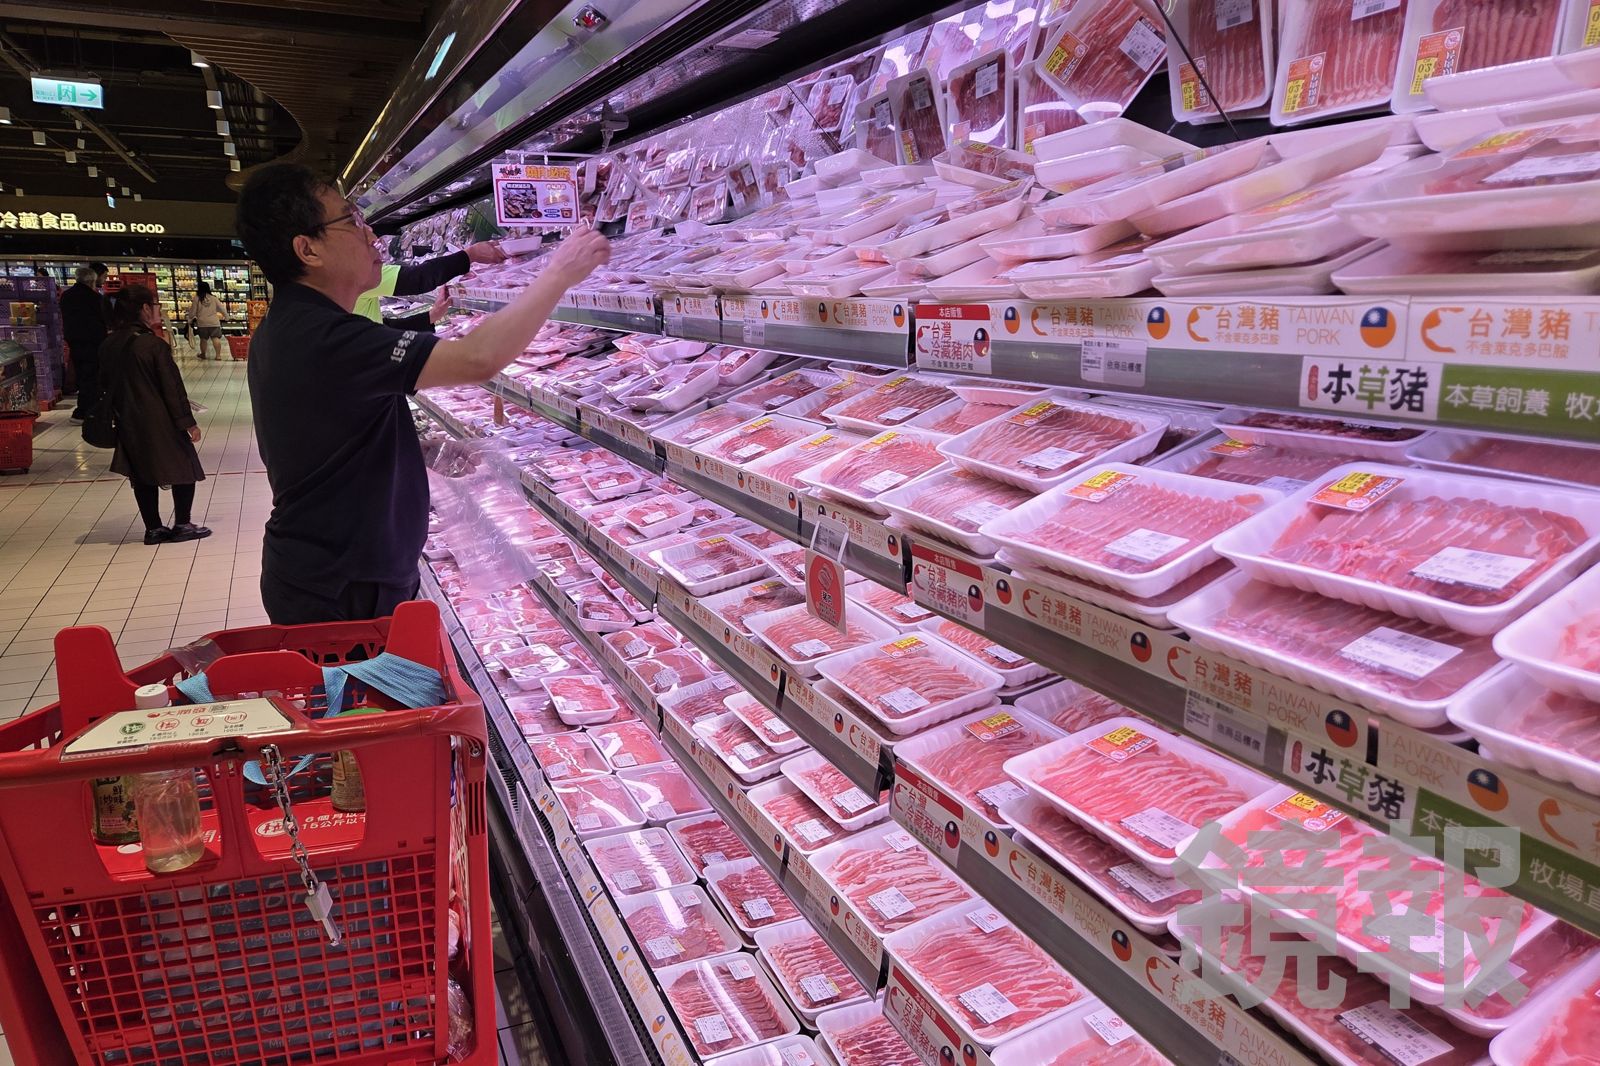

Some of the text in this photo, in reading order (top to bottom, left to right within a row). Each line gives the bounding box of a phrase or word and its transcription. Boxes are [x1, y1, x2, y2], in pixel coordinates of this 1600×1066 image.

[0, 211, 165, 233] 冷藏食品 CHILLED FOOD
[1050, 305, 1093, 326] 台灣豬
[1098, 307, 1143, 321] TAIWAN
[1216, 305, 1279, 330] 台灣豬
[1287, 306, 1354, 325] TAIWAN
[1468, 307, 1571, 340] 台灣豬
[931, 321, 952, 340] 台灣
[1105, 323, 1135, 337] PORK
[1216, 331, 1279, 345] 不含萊克多巴胺
[1297, 328, 1341, 345] PORK
[931, 341, 973, 361] 冷藏豬肉
[1466, 339, 1569, 358] 不含萊克多巴胺
[1322, 363, 1429, 412] 本草豬
[1445, 384, 1550, 417] 本草飼養
[1041, 595, 1081, 626] 台灣豬
[1085, 612, 1128, 640] TAIWAN
[1092, 629, 1119, 651] PORK
[1194, 656, 1252, 696] 台灣豬
[1261, 681, 1321, 719] TAIWAN
[1268, 702, 1308, 731] PORK
[1384, 731, 1462, 776] TAIWAN
[1305, 748, 1405, 819] 本草豬
[1394, 754, 1445, 789] PORK
[1028, 862, 1066, 903] 台灣豬
